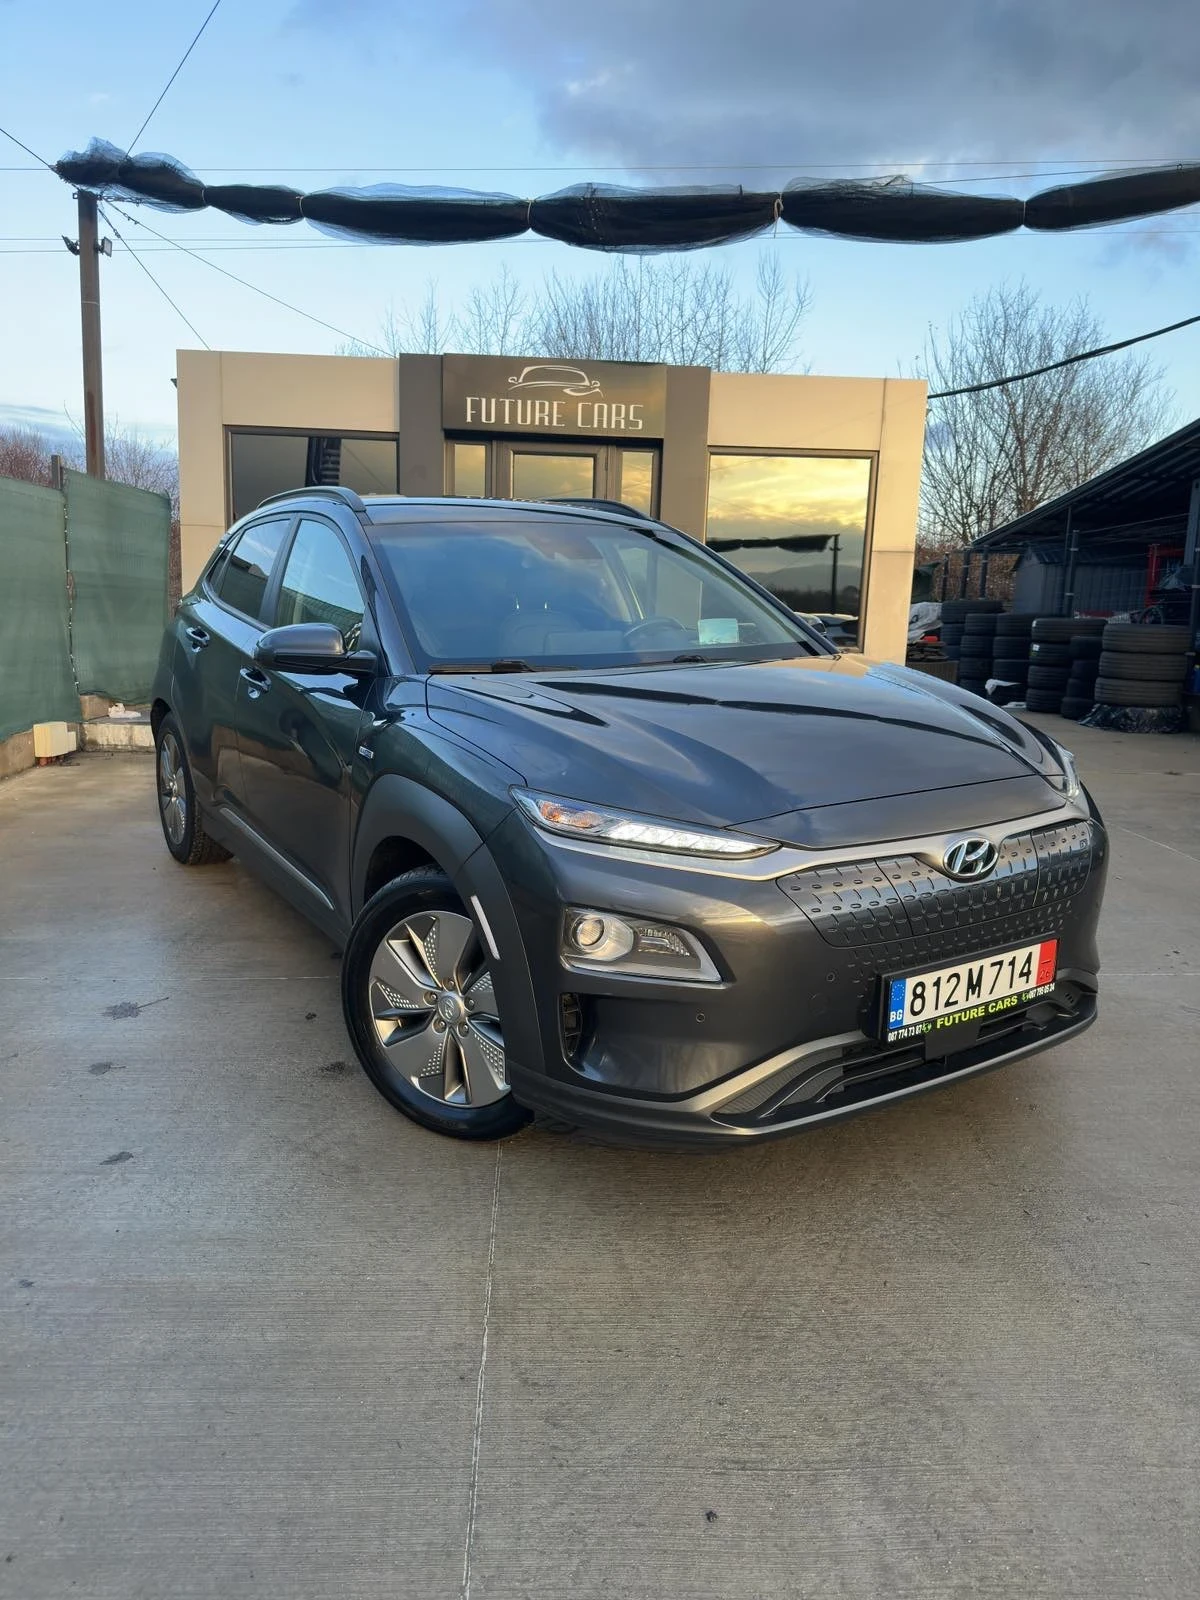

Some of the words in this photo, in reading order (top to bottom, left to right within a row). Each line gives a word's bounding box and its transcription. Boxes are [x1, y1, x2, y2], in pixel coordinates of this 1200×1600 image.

[465, 396, 566, 427] FUTURE
[577, 402, 644, 430] CARS
[909, 951, 1033, 1017] 812M714
[889, 1008, 903, 1023] BG
[936, 1006, 985, 1029] FUTURE
[988, 995, 1018, 1013] CARS
